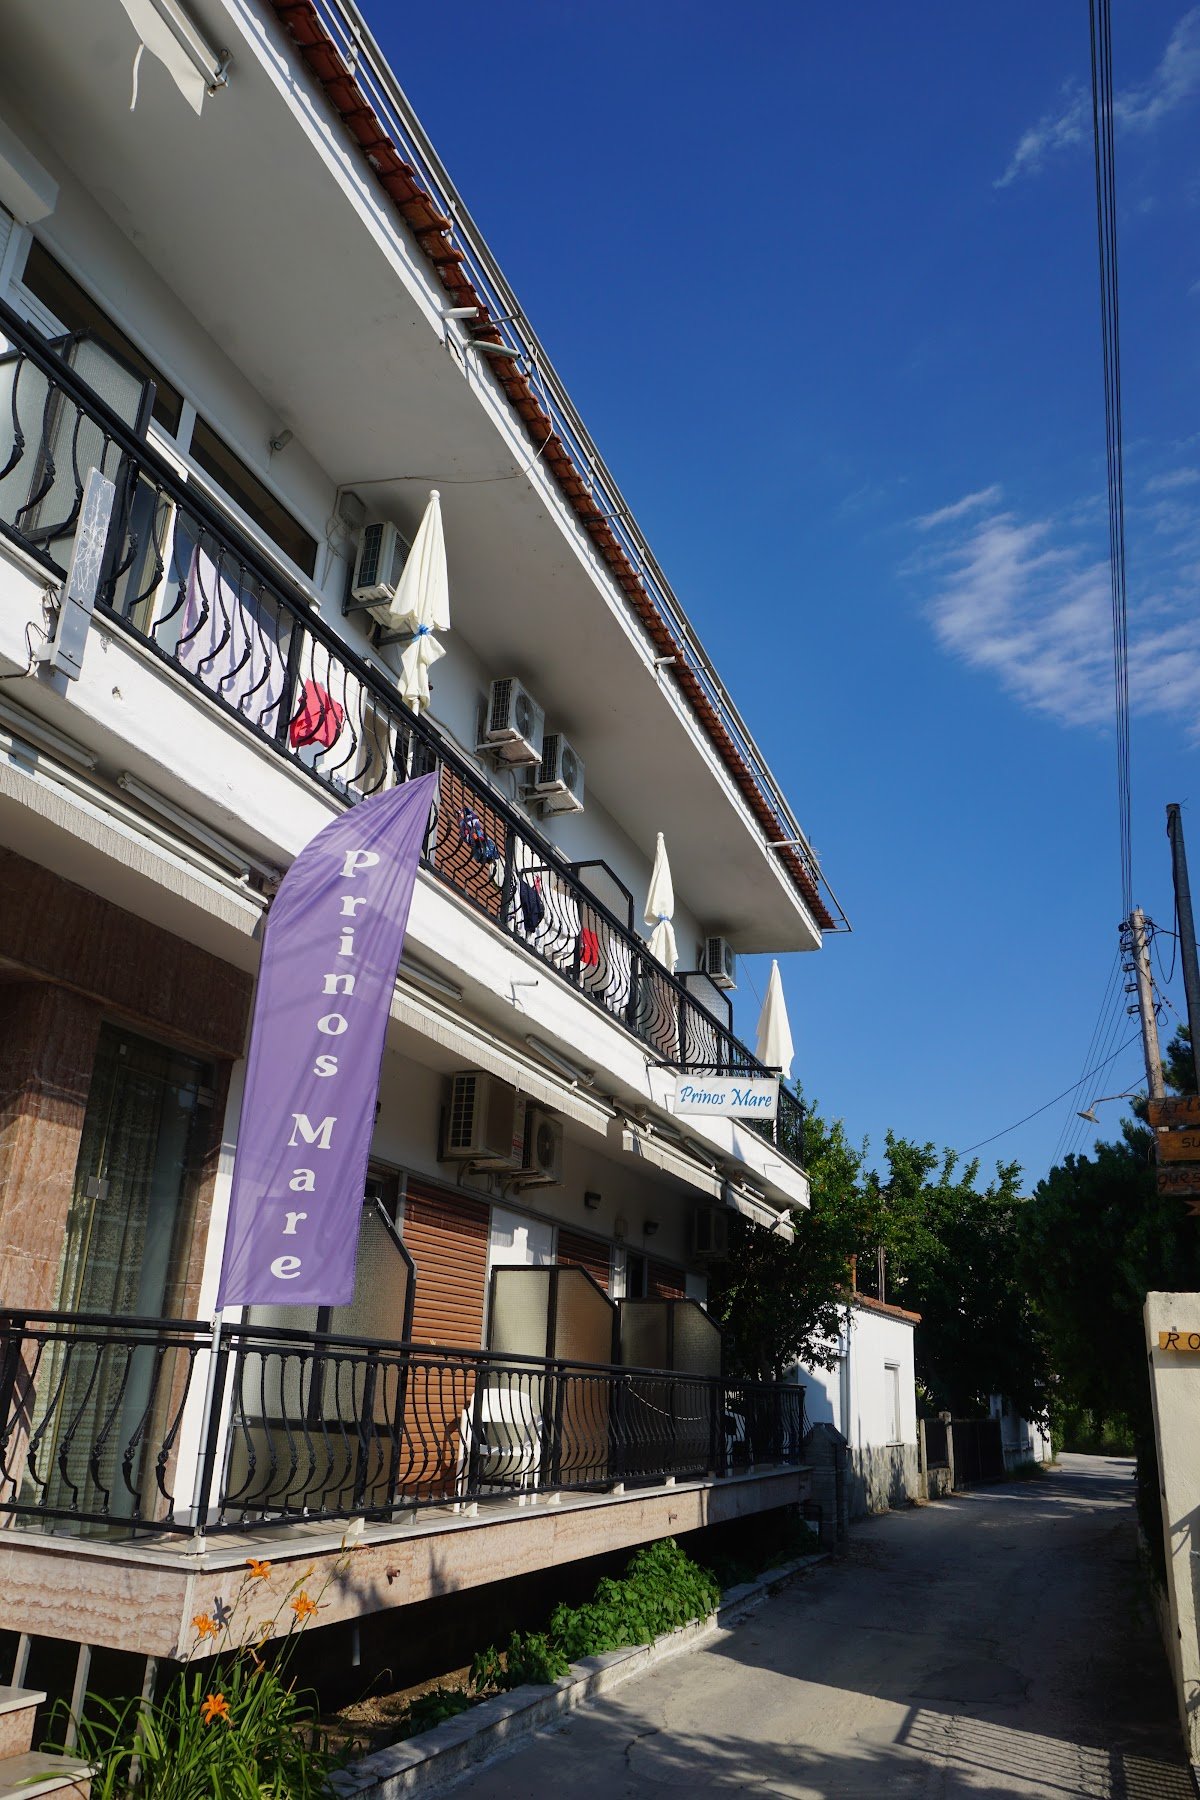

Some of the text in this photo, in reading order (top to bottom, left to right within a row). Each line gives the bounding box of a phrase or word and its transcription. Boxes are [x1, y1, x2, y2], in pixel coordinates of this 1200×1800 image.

[270, 849, 380, 1280] Prinos Mare
[680, 1086, 772, 1108] Prinos Mare
